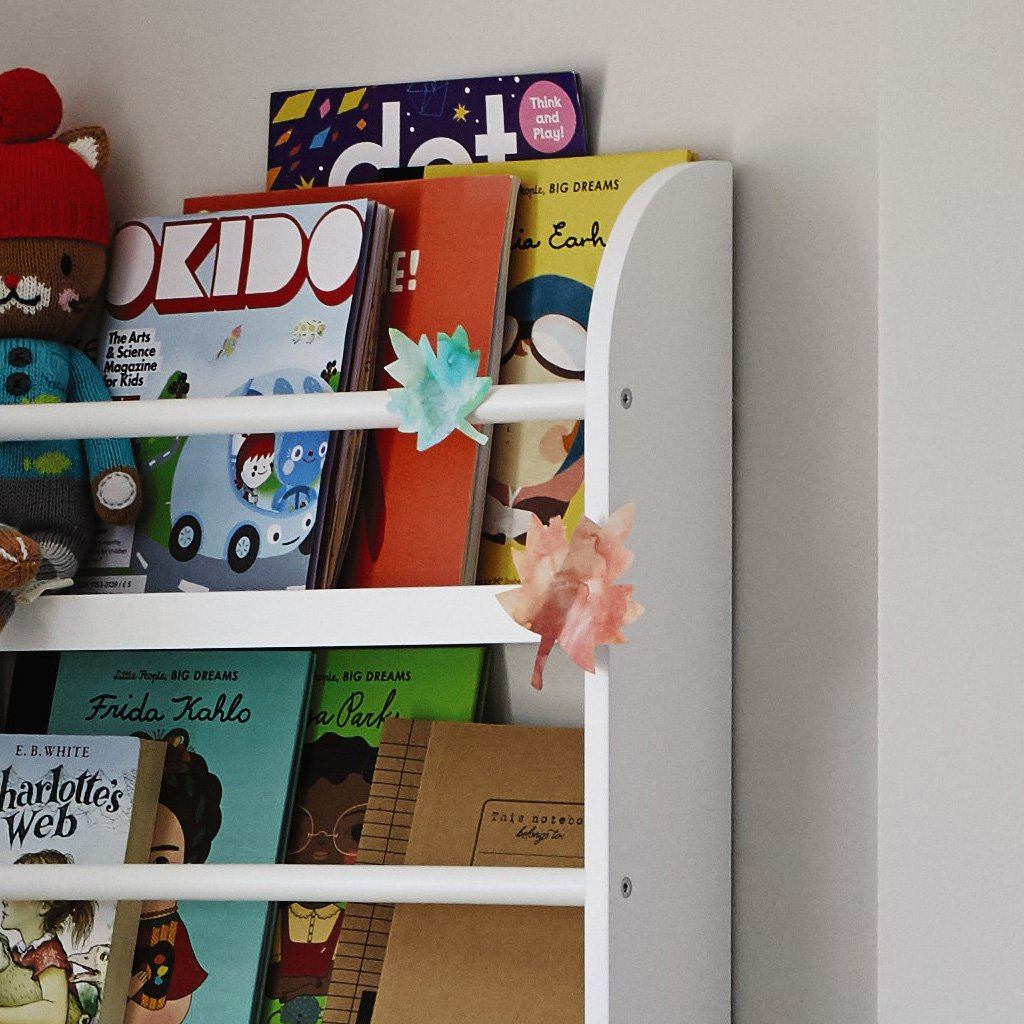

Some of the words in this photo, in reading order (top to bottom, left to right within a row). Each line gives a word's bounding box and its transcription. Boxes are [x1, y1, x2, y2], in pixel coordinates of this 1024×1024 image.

[530, 95, 562, 109] Think
[536, 111, 559, 124] and
[533, 126, 564, 142] Play!
[549, 182, 569, 194] BIG
[573, 179, 620, 193] DREAMS
[106, 204, 365, 320] OKIDO
[109, 332, 126, 344] The
[129, 331, 150, 343] Arts
[105, 346, 114, 359] &
[117, 345, 156, 358] Science
[104, 359, 157, 373] Magazine
[120, 373, 144, 387] Kids
[113, 669, 137, 680] Little
[138, 669, 167, 685] People,
[171, 670, 190, 681] BIG
[194, 670, 238, 682] DREAMS
[343, 670, 362, 681] BIG
[366, 671, 411, 682] DREAMS
[85, 692, 165, 722] Frida
[171, 692, 252, 724] Kahlo
[337, 689, 400, 728] Park
[15, 744, 26, 757] E.
[31, 744, 42, 757] B.
[44, 745, 90, 758] WHITE
[492, 811, 525, 823] This
[2, 802, 77, 848] Web
[516, 825, 549, 846] belongs
